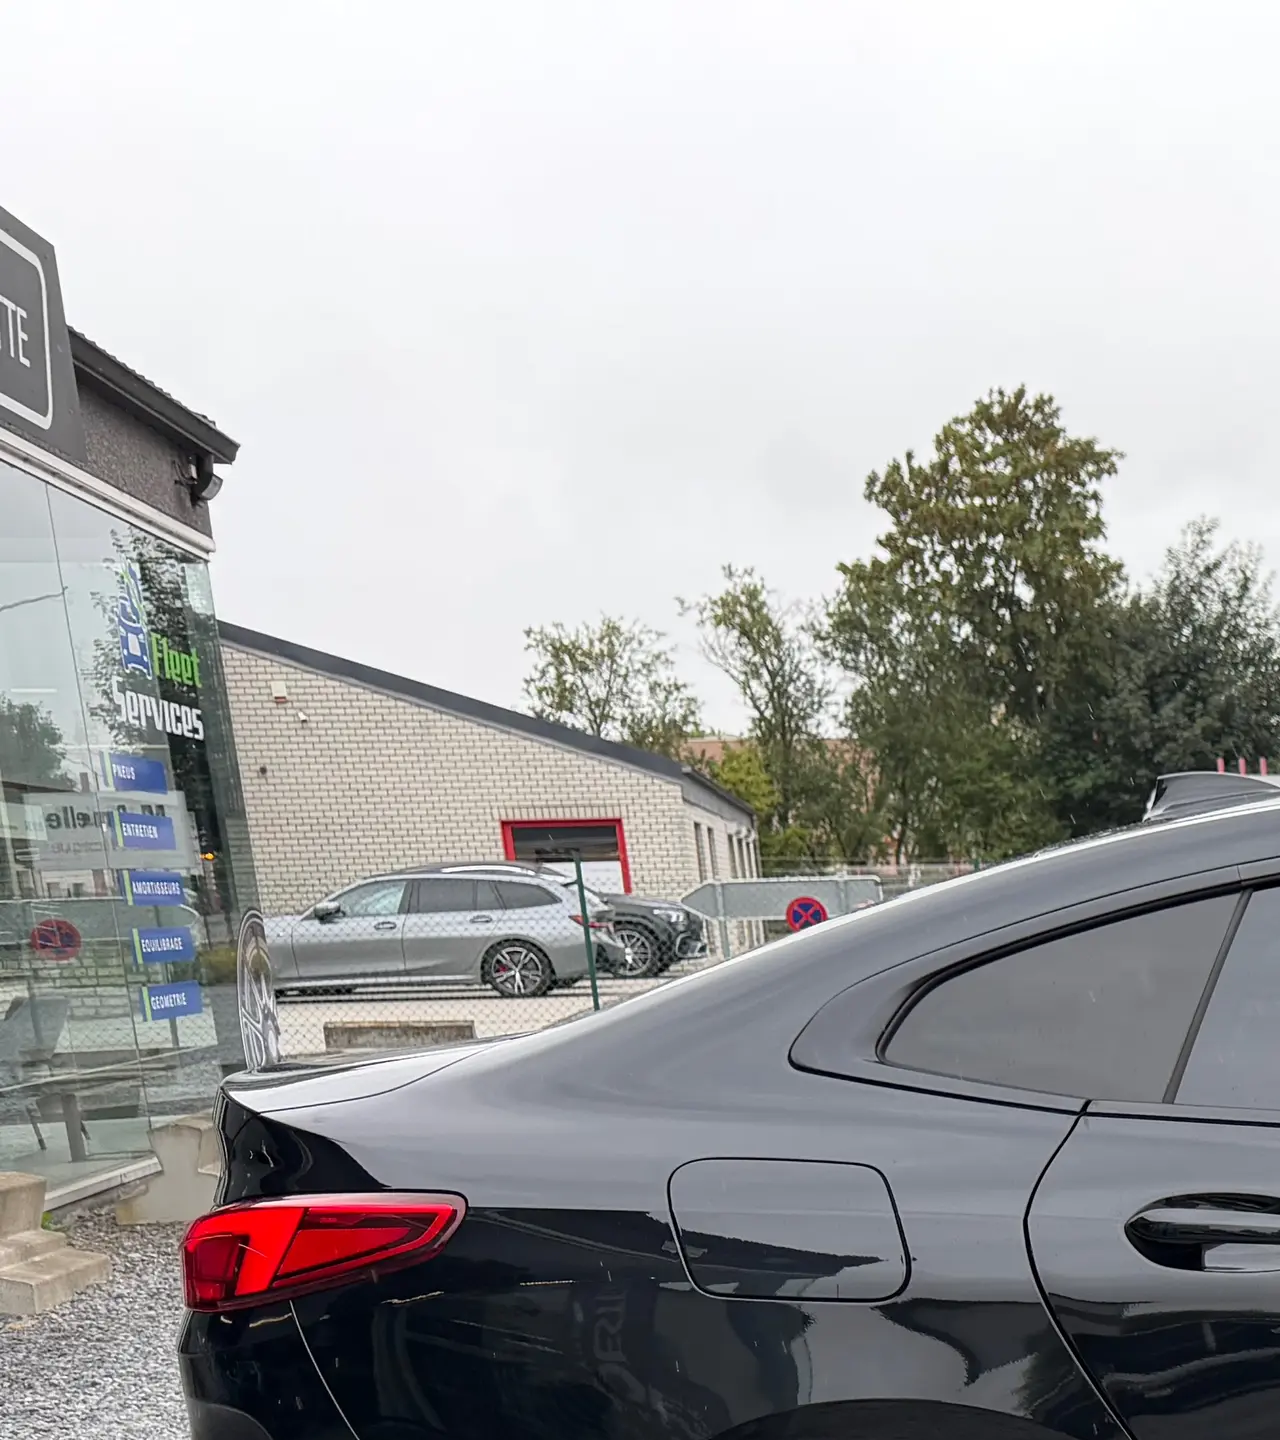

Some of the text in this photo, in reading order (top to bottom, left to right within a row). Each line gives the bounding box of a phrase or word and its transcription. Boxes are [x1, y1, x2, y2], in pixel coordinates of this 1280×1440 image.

[0, 294, 31, 368] TE
[150, 631, 202, 688] Fleet
[112, 674, 204, 741] Services
[112, 763, 136, 780] PNEUS
[121, 822, 158, 839] ENTRETIEN
[132, 881, 181, 896] AMORTISSEURS
